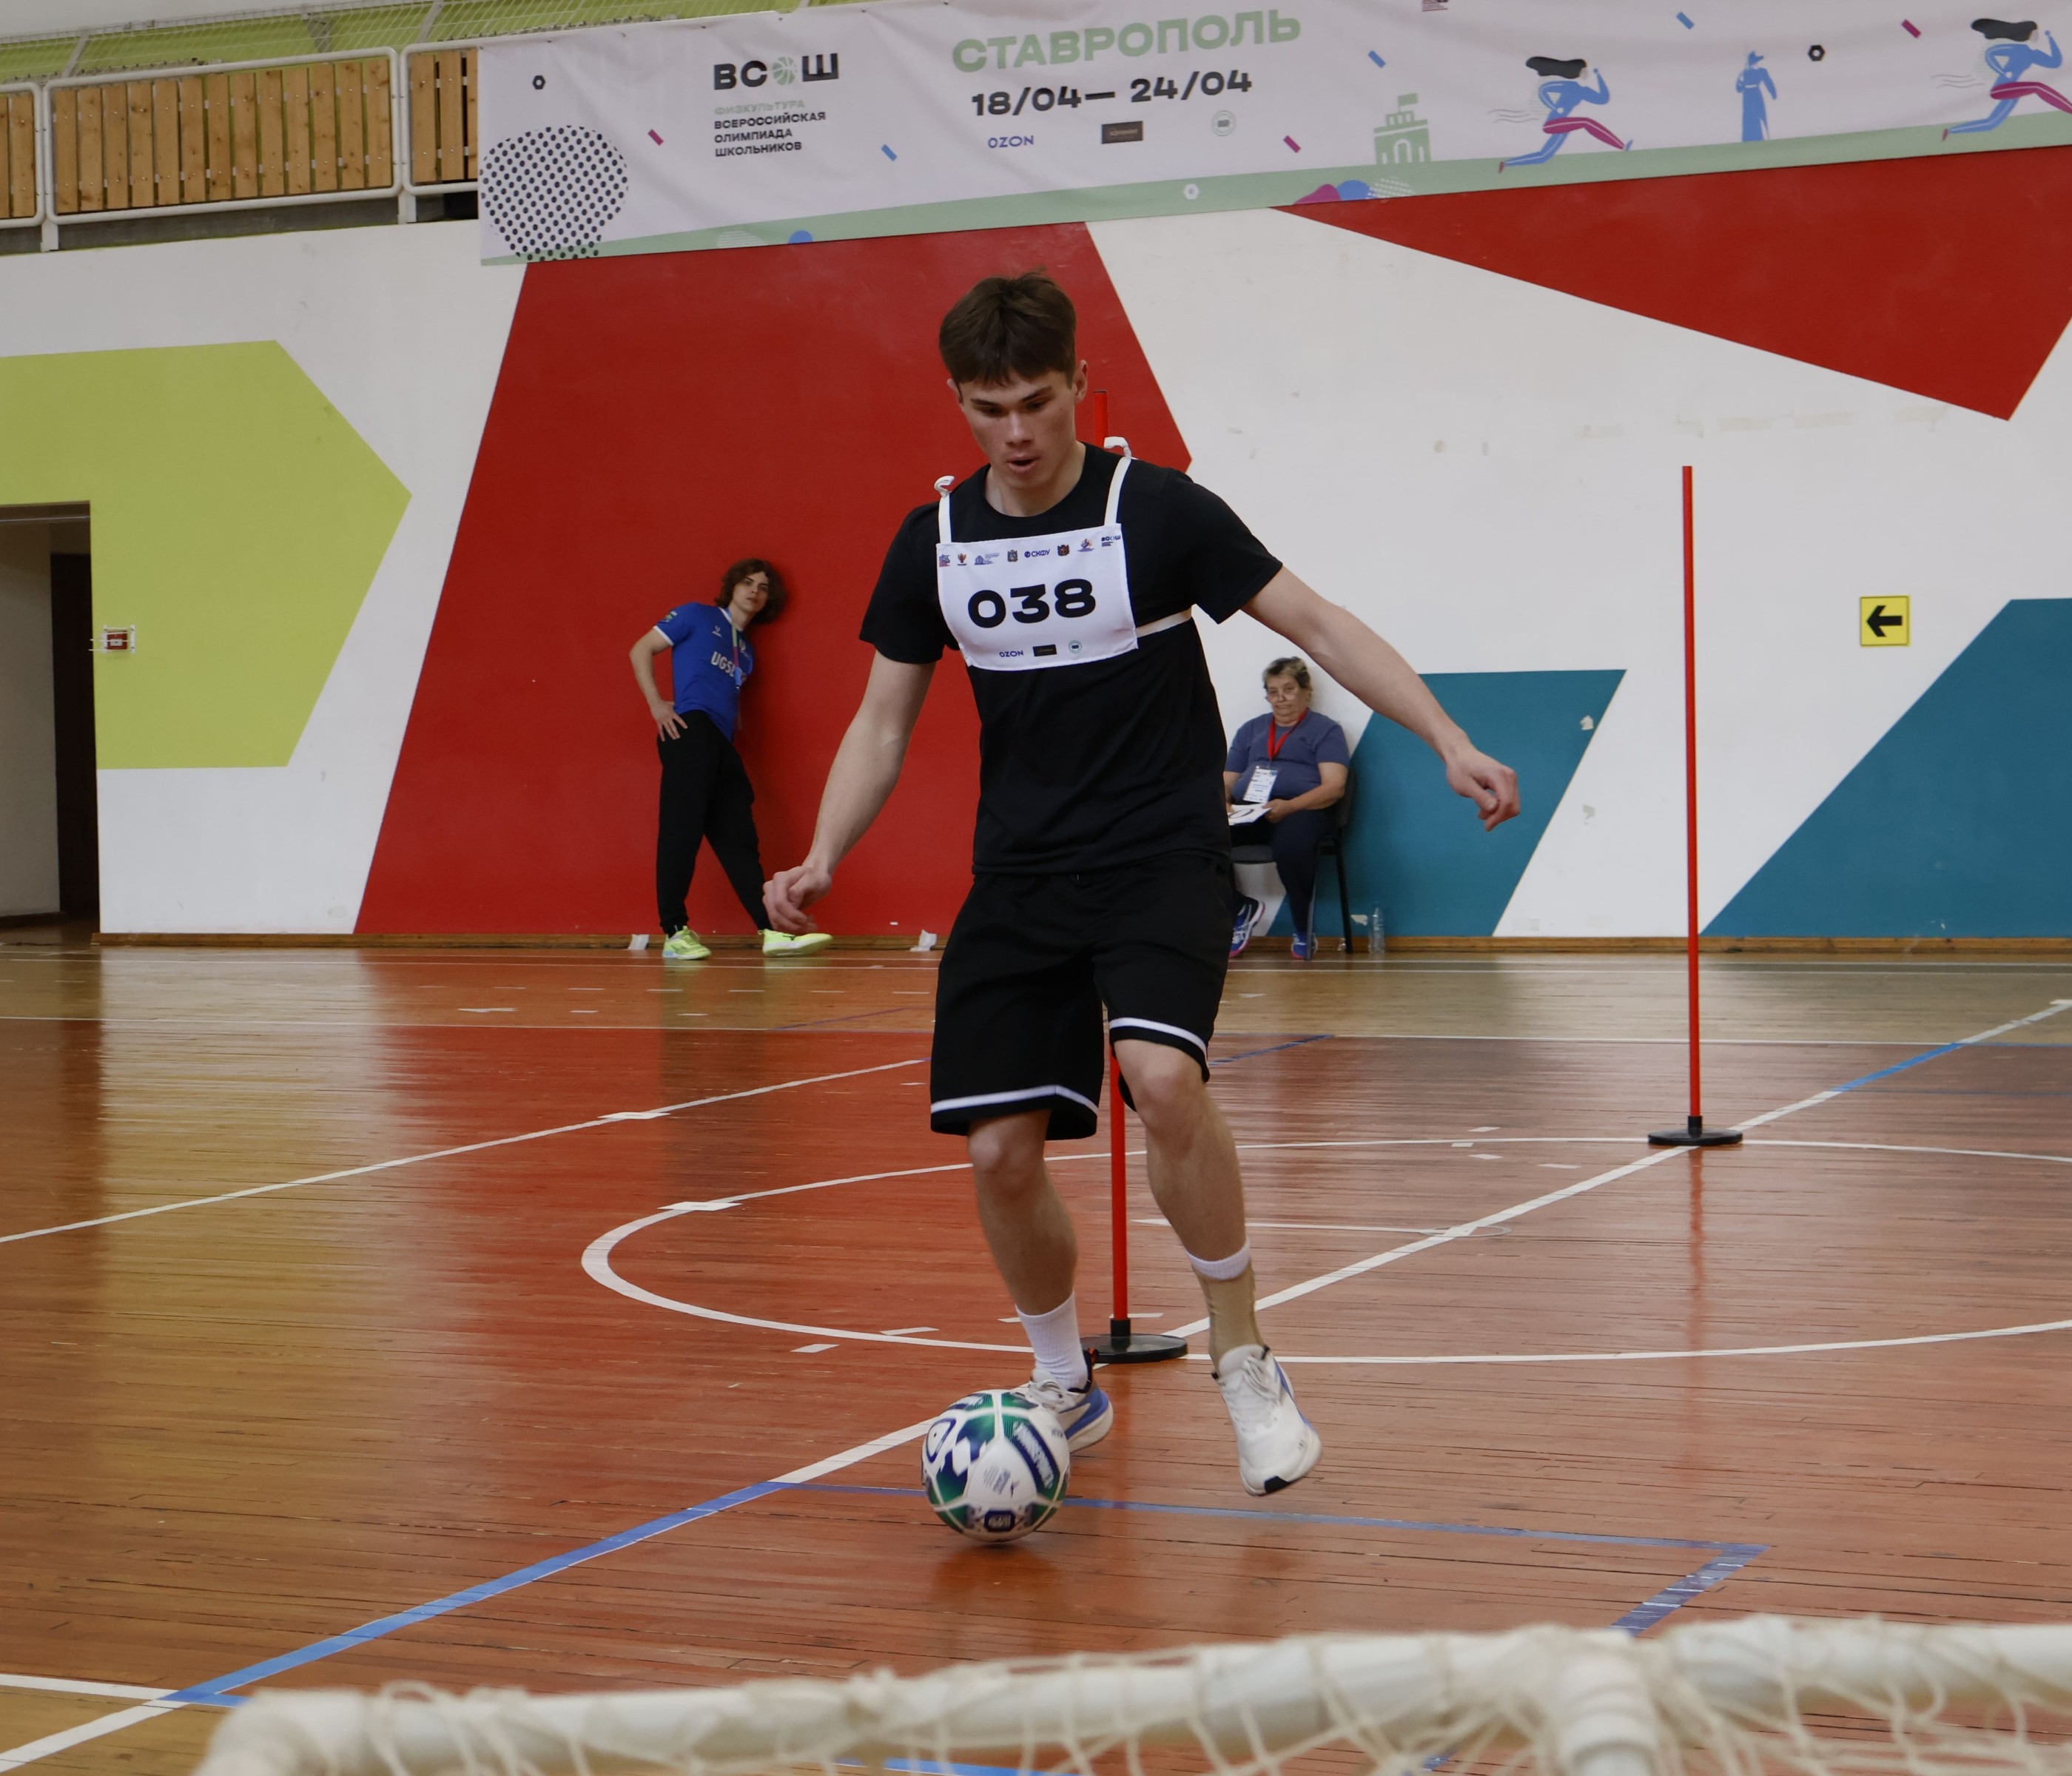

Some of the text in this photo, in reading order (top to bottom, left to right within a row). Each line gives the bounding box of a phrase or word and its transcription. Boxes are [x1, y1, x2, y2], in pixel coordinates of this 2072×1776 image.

[952, 9, 1302, 73] СТАВРОПОЛЬ
[1130, 70, 1252, 102] 24/04
[714, 99, 805, 115] ФИЗКУЛЬТУРА
[714, 111, 826, 130] ВСЕРОССИЙСКАЯ
[714, 128, 793, 144] ОЛИМПИАДА
[988, 135, 1035, 148] OZON
[715, 141, 802, 157] ШКОЛЬНИКОВ
[968, 579, 1096, 628] 038
[999, 650, 1024, 658] OZON
